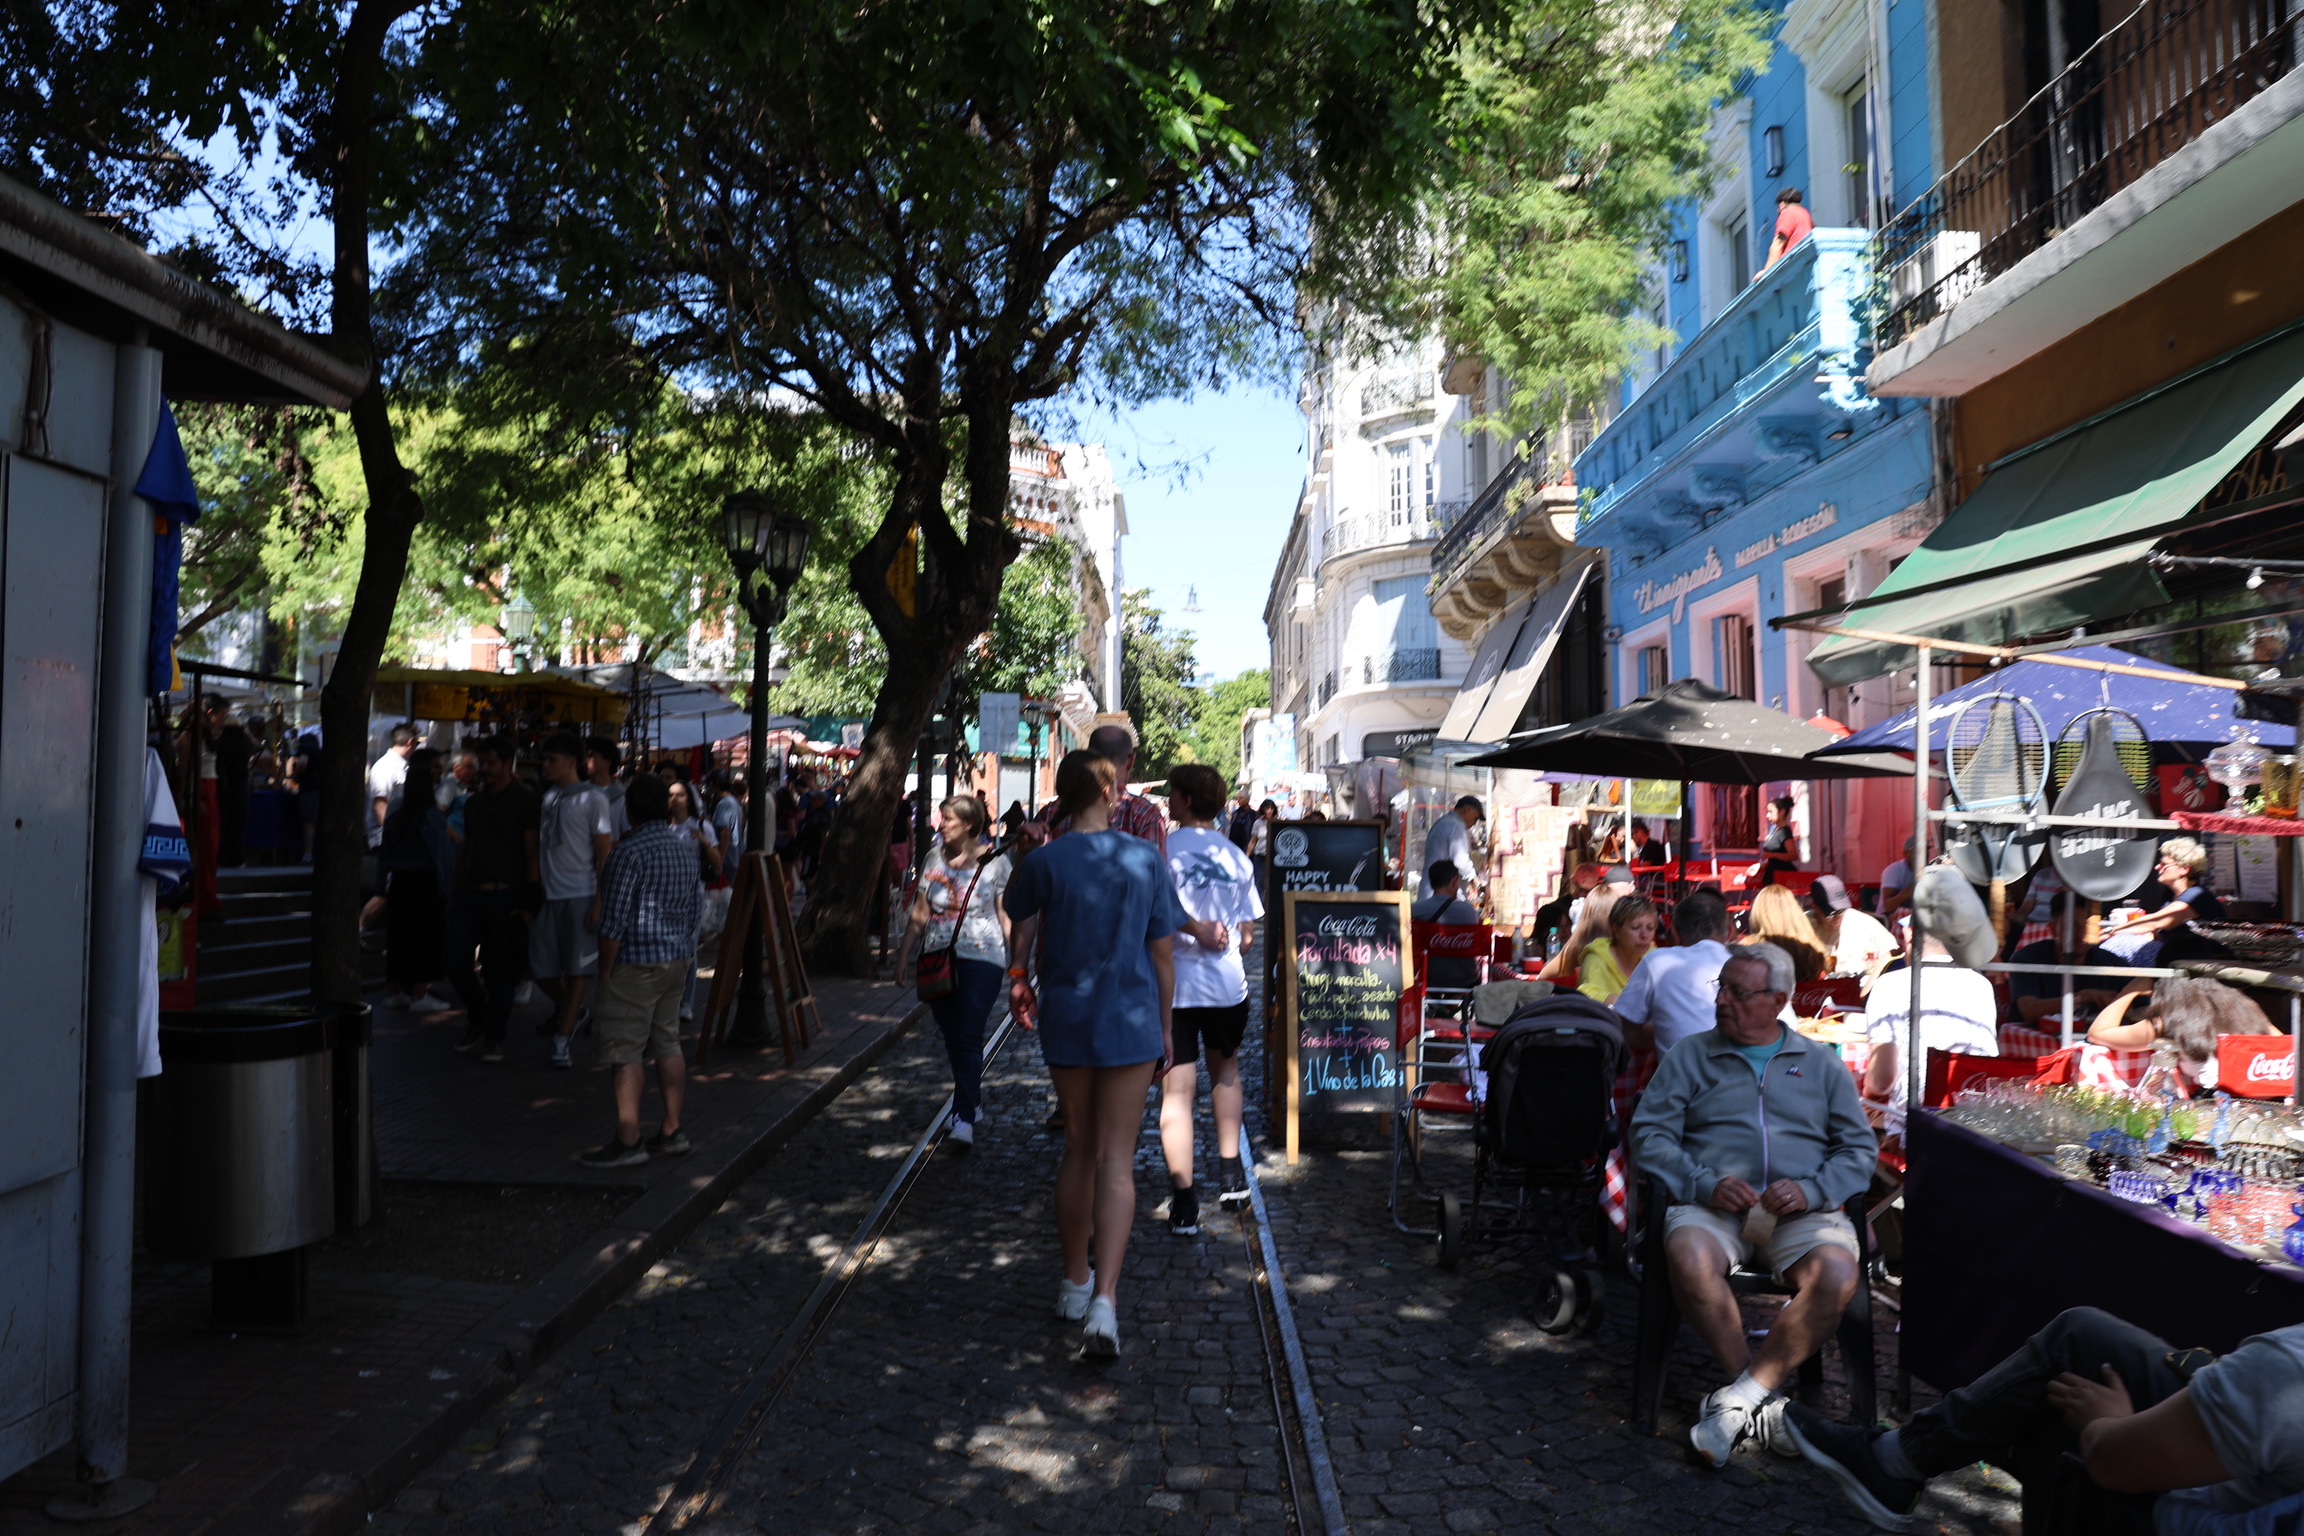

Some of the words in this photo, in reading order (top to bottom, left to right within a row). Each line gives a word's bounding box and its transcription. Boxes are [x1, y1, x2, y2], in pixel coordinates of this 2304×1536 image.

[1285, 870, 1331, 884] HAPPY
[1318, 914, 1379, 938] Coca-Cola
[1297, 932, 1371, 965] Parrillada
[1429, 931, 1477, 949] Coca-Cola
[1303, 1058, 1318, 1095] 1
[1315, 1054, 1342, 1091] Vino
[1343, 1066, 1359, 1090] de
[1360, 1058, 1372, 1089] la
